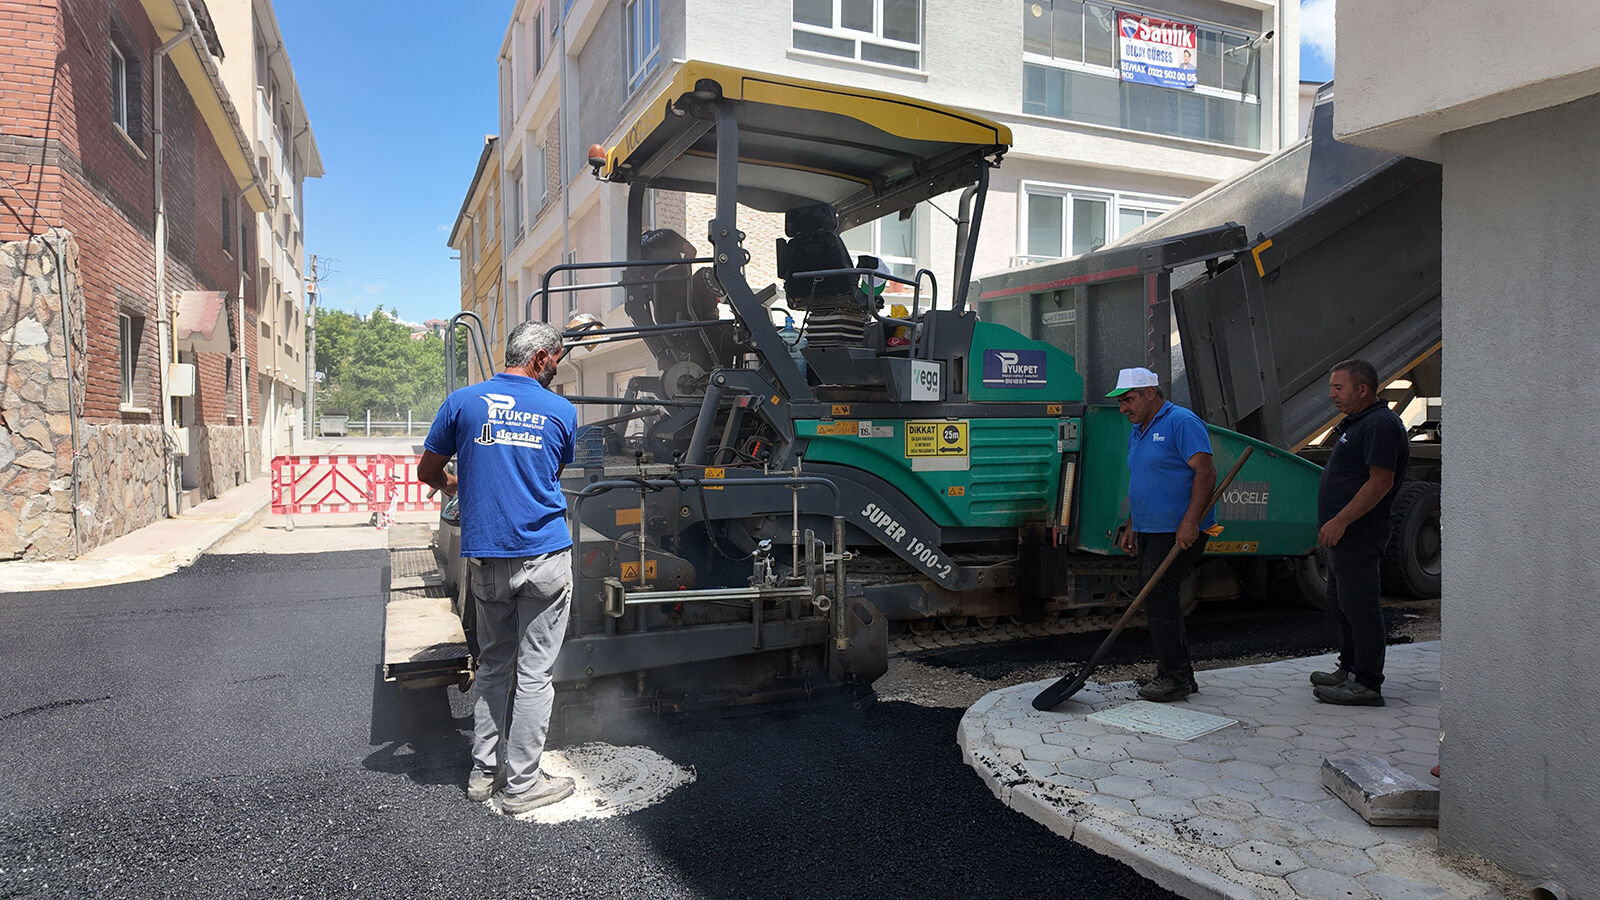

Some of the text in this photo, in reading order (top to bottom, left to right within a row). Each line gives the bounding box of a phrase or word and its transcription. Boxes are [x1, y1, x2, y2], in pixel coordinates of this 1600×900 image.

[1147, 47, 1173, 63] GÜRSES
[1121, 62, 1146, 74] RE/MAX
[1147, 67, 1163, 78] 0222
[1164, 70, 1176, 79] 502
[1007, 364, 1038, 375] YUKPET
[497, 409, 548, 425] YUKPET
[944, 430, 959, 440] 25m
[1222, 489, 1270, 505] VÖGELE
[861, 503, 952, 580] SUPER 1900-2
